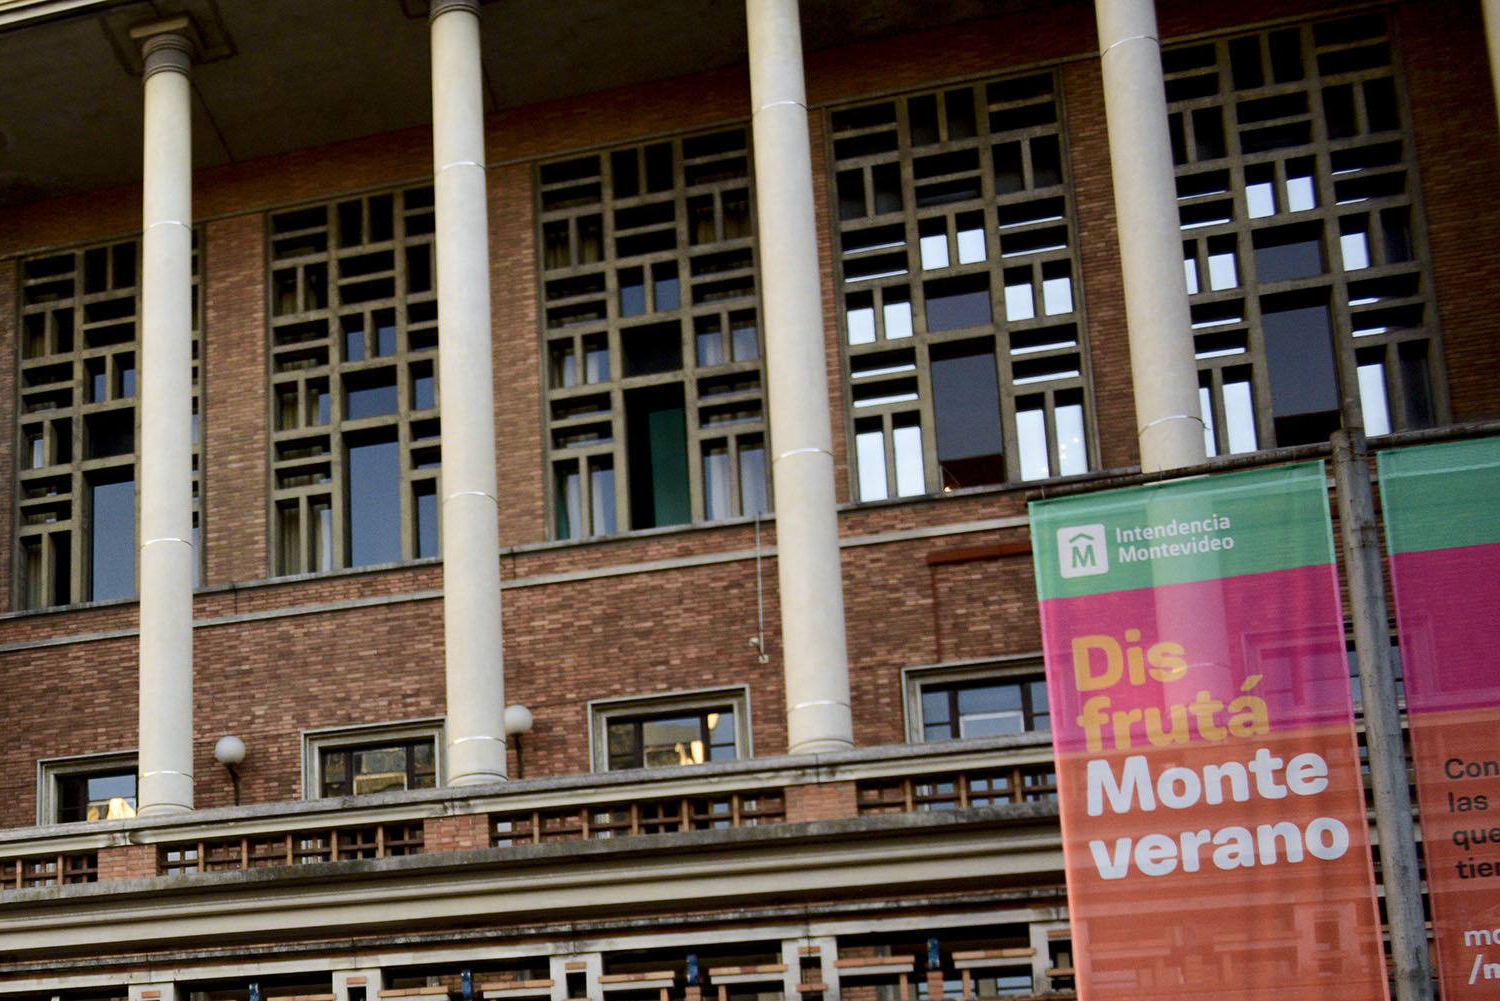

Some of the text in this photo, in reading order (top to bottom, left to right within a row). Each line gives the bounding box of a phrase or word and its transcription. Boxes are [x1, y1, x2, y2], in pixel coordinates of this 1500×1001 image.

[1116, 513, 1231, 544] Intendencia
[1117, 534, 1234, 563] Montevideo
[1071, 628, 1188, 692] Dis
[1076, 674, 1271, 754] frutá
[1086, 748, 1329, 817] Monte
[1448, 792, 1489, 813] las
[1089, 817, 1350, 880] verano
